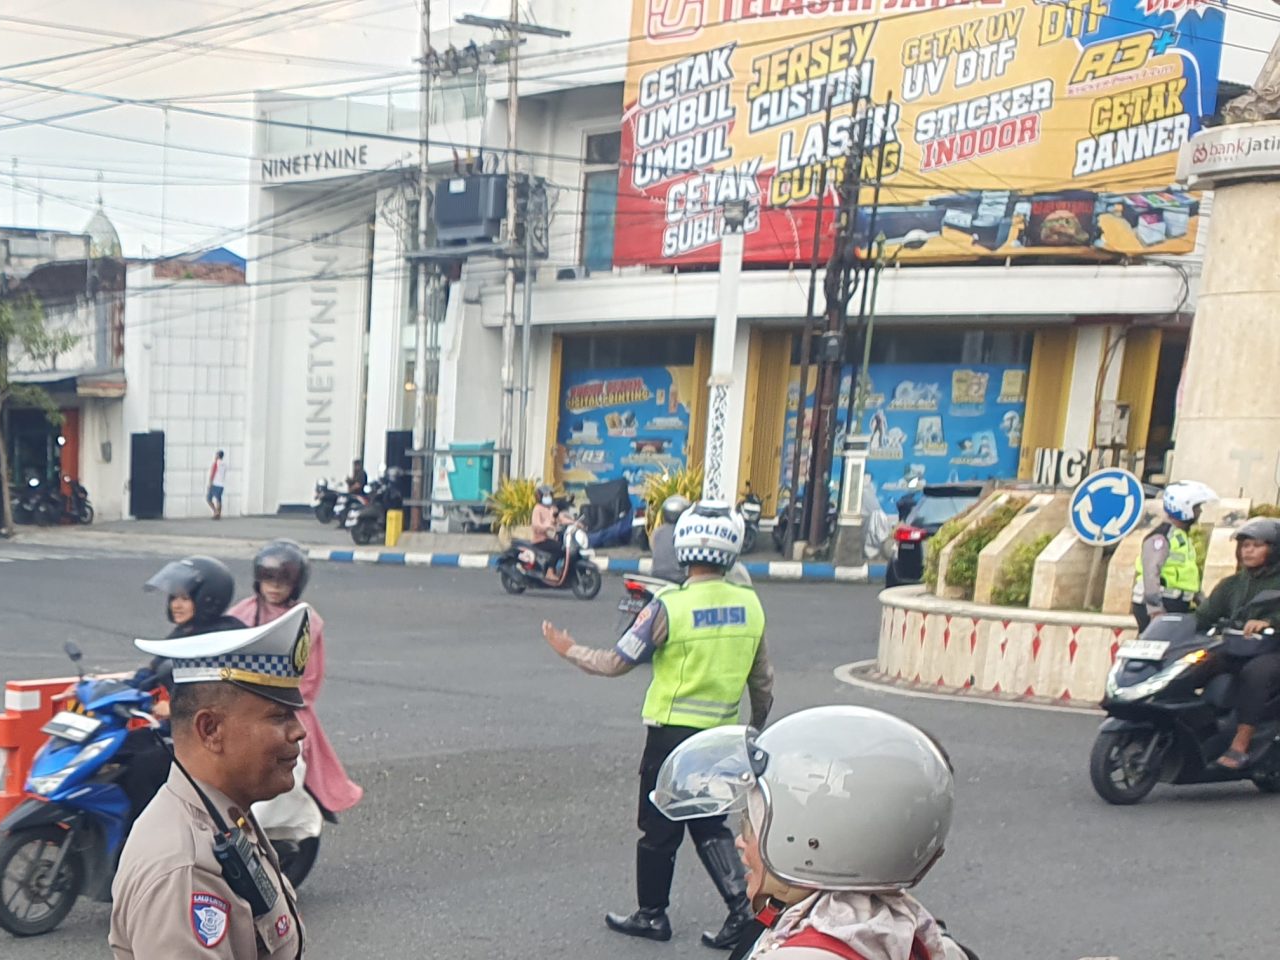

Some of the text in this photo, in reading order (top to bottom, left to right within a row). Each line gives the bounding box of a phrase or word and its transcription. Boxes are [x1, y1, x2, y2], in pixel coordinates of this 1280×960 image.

[748, 20, 879, 98] JERSEY
[902, 8, 1025, 67] CETAK UV
[639, 43, 736, 107] CETAK
[750, 59, 874, 134] CUSTOM
[902, 57, 948, 102] UV
[955, 38, 1018, 88] DTF
[637, 85, 736, 146] UMBUL
[914, 79, 1054, 143] STICKER
[1089, 78, 1187, 136] CETAK
[261, 144, 369, 180] NINETYNINE
[632, 126, 732, 187] UMBUL
[770, 141, 901, 206] CUTTNG
[921, 113, 1040, 171] INDOOR
[1073, 114, 1191, 177] BANNER
[667, 156, 762, 222] CETAK
[303, 231, 339, 467] NINETYNINE
[686, 523, 733, 541] POLISI
[692, 606, 747, 628] POLISI
